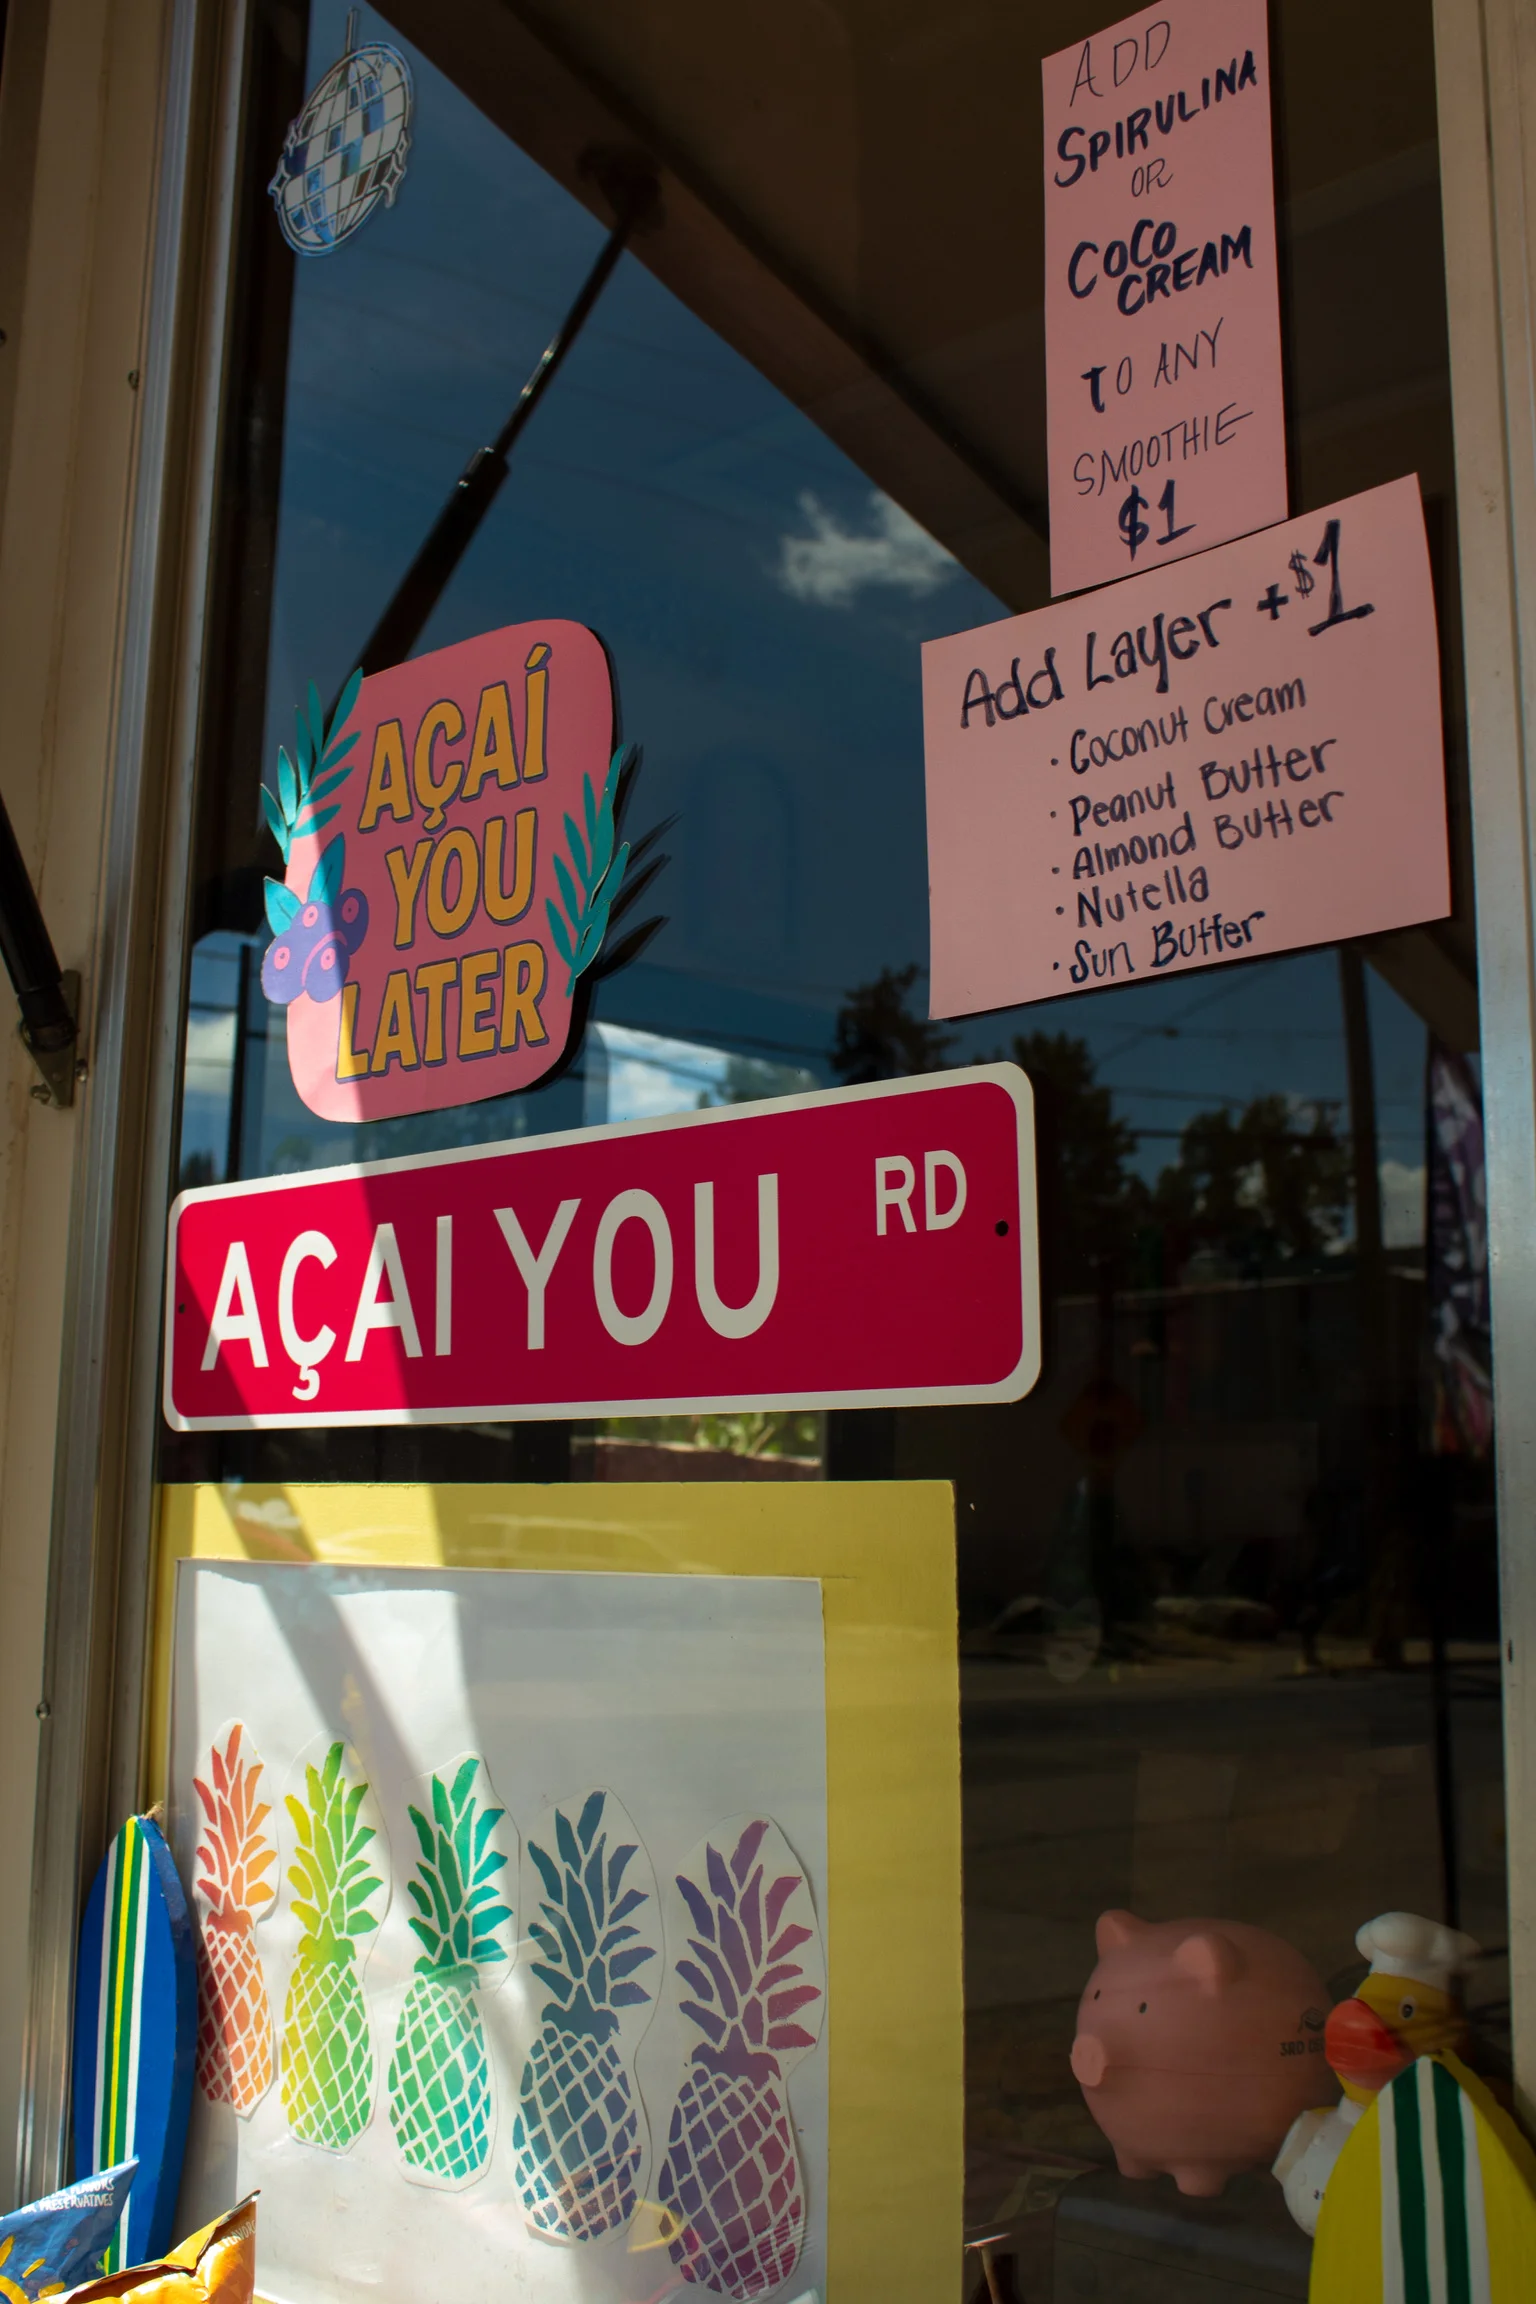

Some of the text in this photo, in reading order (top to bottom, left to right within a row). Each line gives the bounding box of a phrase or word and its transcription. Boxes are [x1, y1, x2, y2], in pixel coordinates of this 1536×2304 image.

[1069, 20, 1171, 107] ADD
[1053, 49, 1258, 188] SPIRULINA
[1131, 158, 1174, 198] OR
[1067, 218, 1177, 299] COCO
[1117, 224, 1254, 316] CREAM
[1154, 317, 1224, 388] ANY
[1073, 402, 1254, 496] SMOOTHIE
[1118, 478, 1197, 561] $1
[959, 647, 1065, 729] Add
[1086, 598, 1232, 694] Layer
[357, 642, 552, 835] AÇAÍ
[1069, 677, 1307, 775] Coconut Cream
[1069, 738, 1337, 837] Peanut Butter
[385, 807, 539, 951] YOU
[1072, 790, 1345, 880] Almond Butter
[1076, 865, 1210, 929] Nutella
[1070, 910, 1266, 985] Sun Butter
[335, 939, 551, 1086] LATER
[200, 1149, 968, 1401] AÇAI YOU RD
[1279, 2040, 1305, 2057] 3RD
